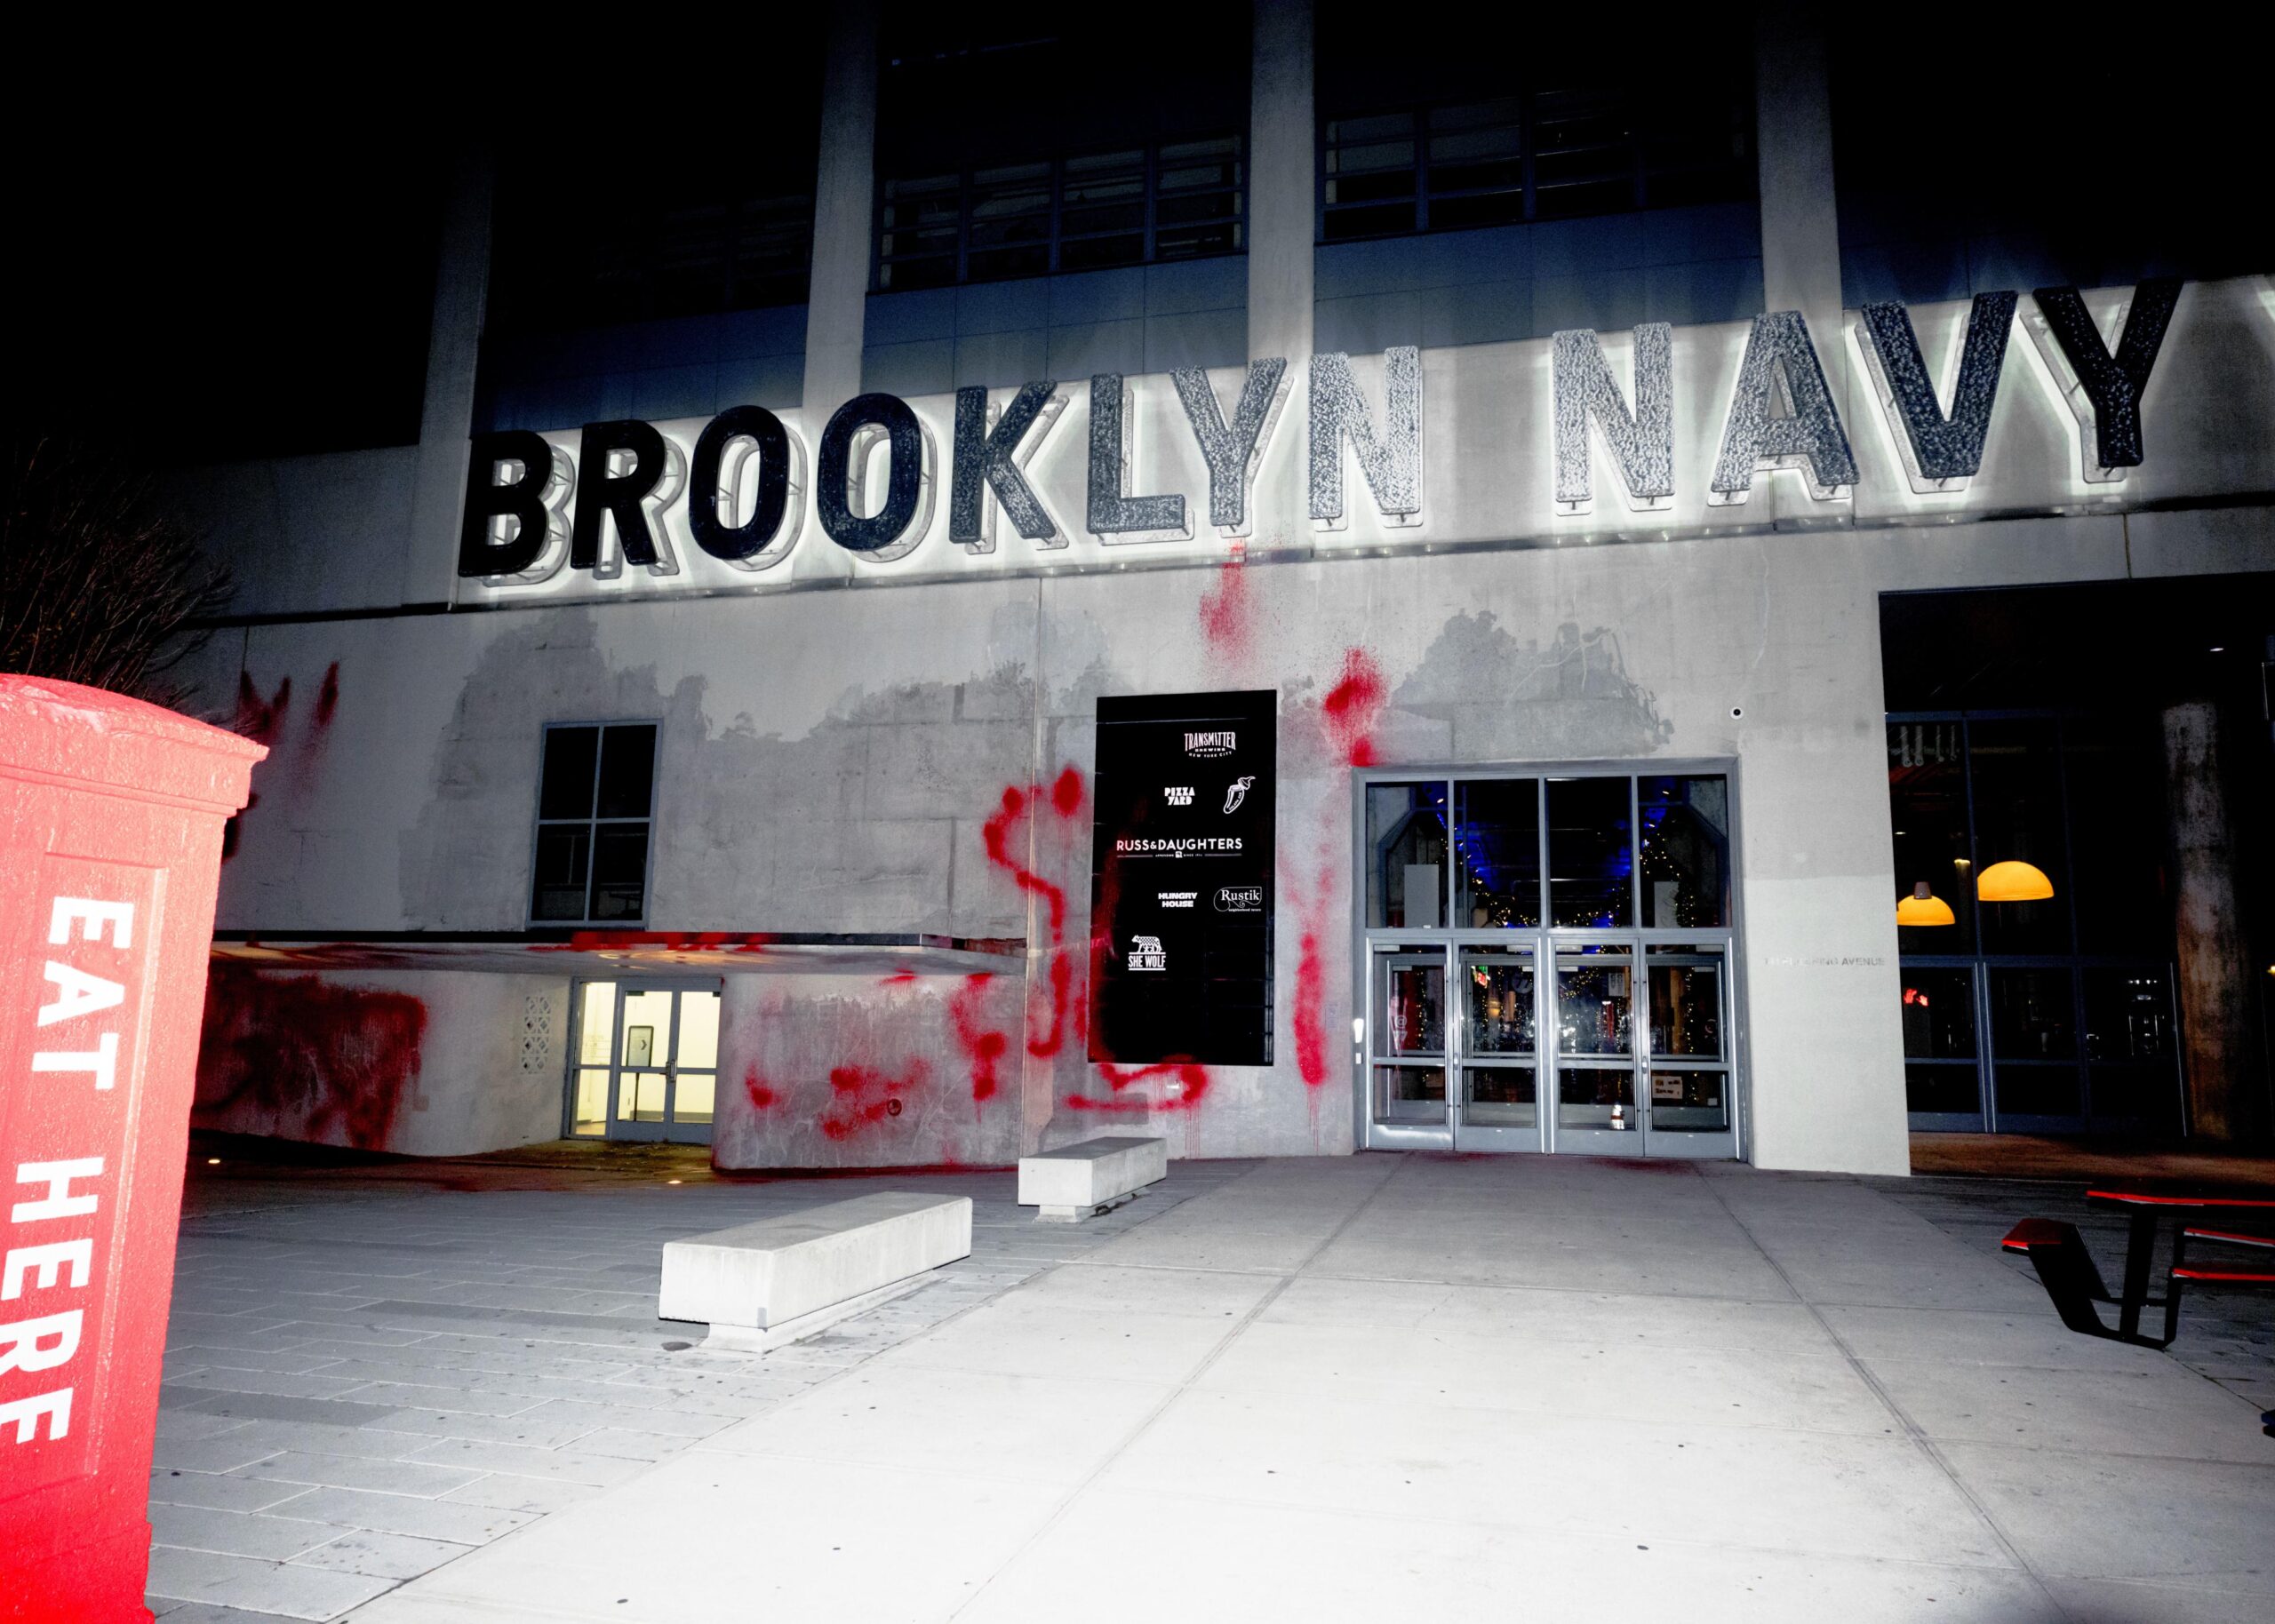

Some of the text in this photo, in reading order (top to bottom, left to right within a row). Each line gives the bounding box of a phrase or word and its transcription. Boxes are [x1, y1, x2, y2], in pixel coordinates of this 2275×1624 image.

[458, 276, 2185, 582] BROOKLYN NAVY
[1184, 731, 1236, 752] TRANSMITTER
[1164, 787, 1195, 797] PIZZA
[1168, 797, 1193, 806] YARD
[1220, 889, 1260, 901] Rustik
[1128, 955, 1166, 967] SHE WOLF
[1841, 957, 1886, 967] AVENUE
[0, 896, 135, 1445] EAT HERE
